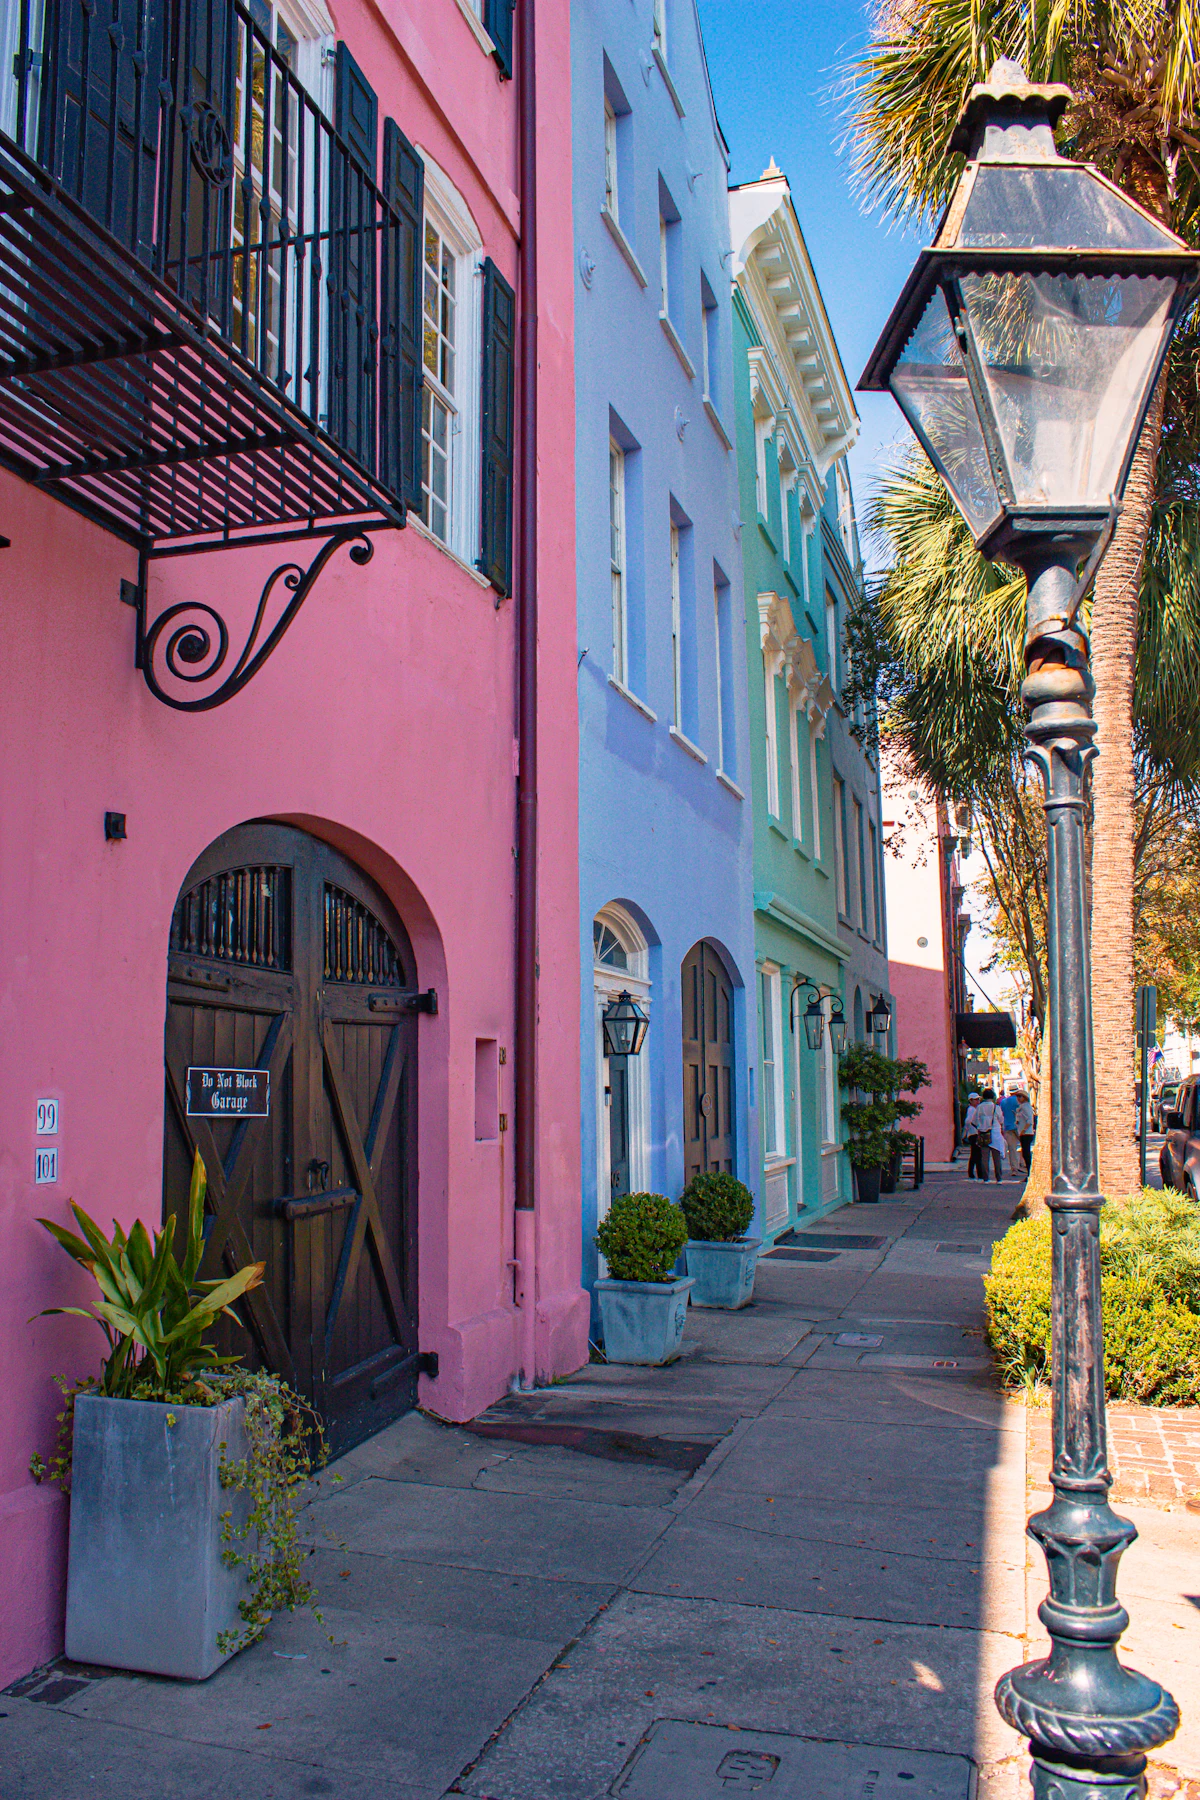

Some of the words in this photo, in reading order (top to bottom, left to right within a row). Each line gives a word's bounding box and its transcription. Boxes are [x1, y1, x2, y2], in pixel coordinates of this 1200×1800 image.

[202, 1072, 213, 1087] Do
[217, 1072, 232, 1088] Not
[236, 1073, 257, 1088] Block
[211, 1091, 248, 1112] Garage
[38, 1104, 55, 1129] 99
[37, 1153, 55, 1178] 101
